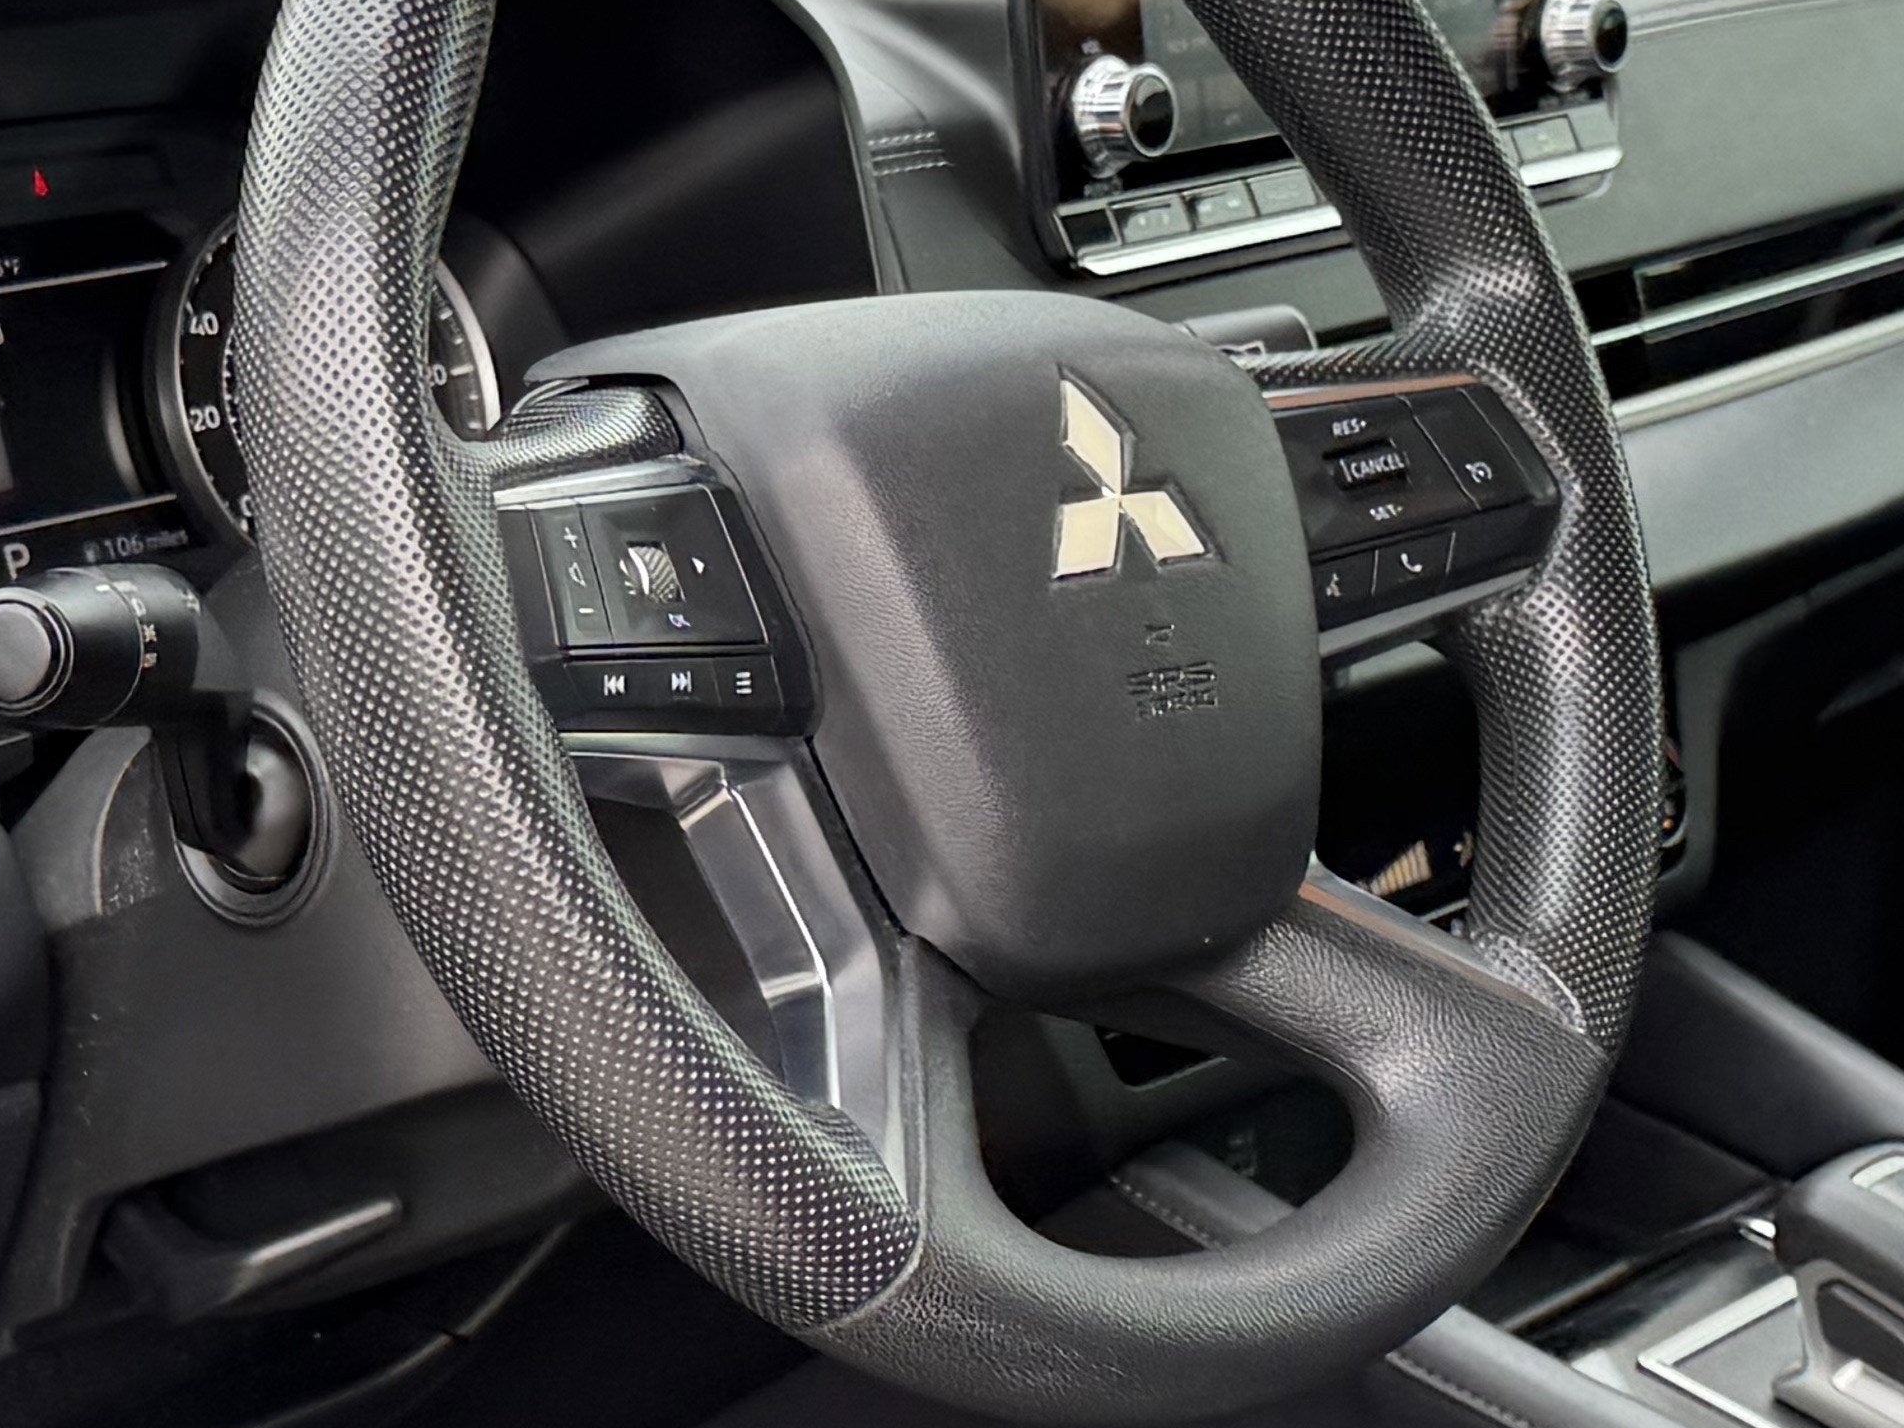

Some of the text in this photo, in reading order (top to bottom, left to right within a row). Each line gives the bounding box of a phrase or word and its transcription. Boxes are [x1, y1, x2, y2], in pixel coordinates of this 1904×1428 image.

[190, 311, 219, 336] 40
[190, 404, 221, 433] 20
[1350, 452, 1405, 479] CANCEL
[103, 534, 144, 561] 106
[2, 542, 31, 582] P
